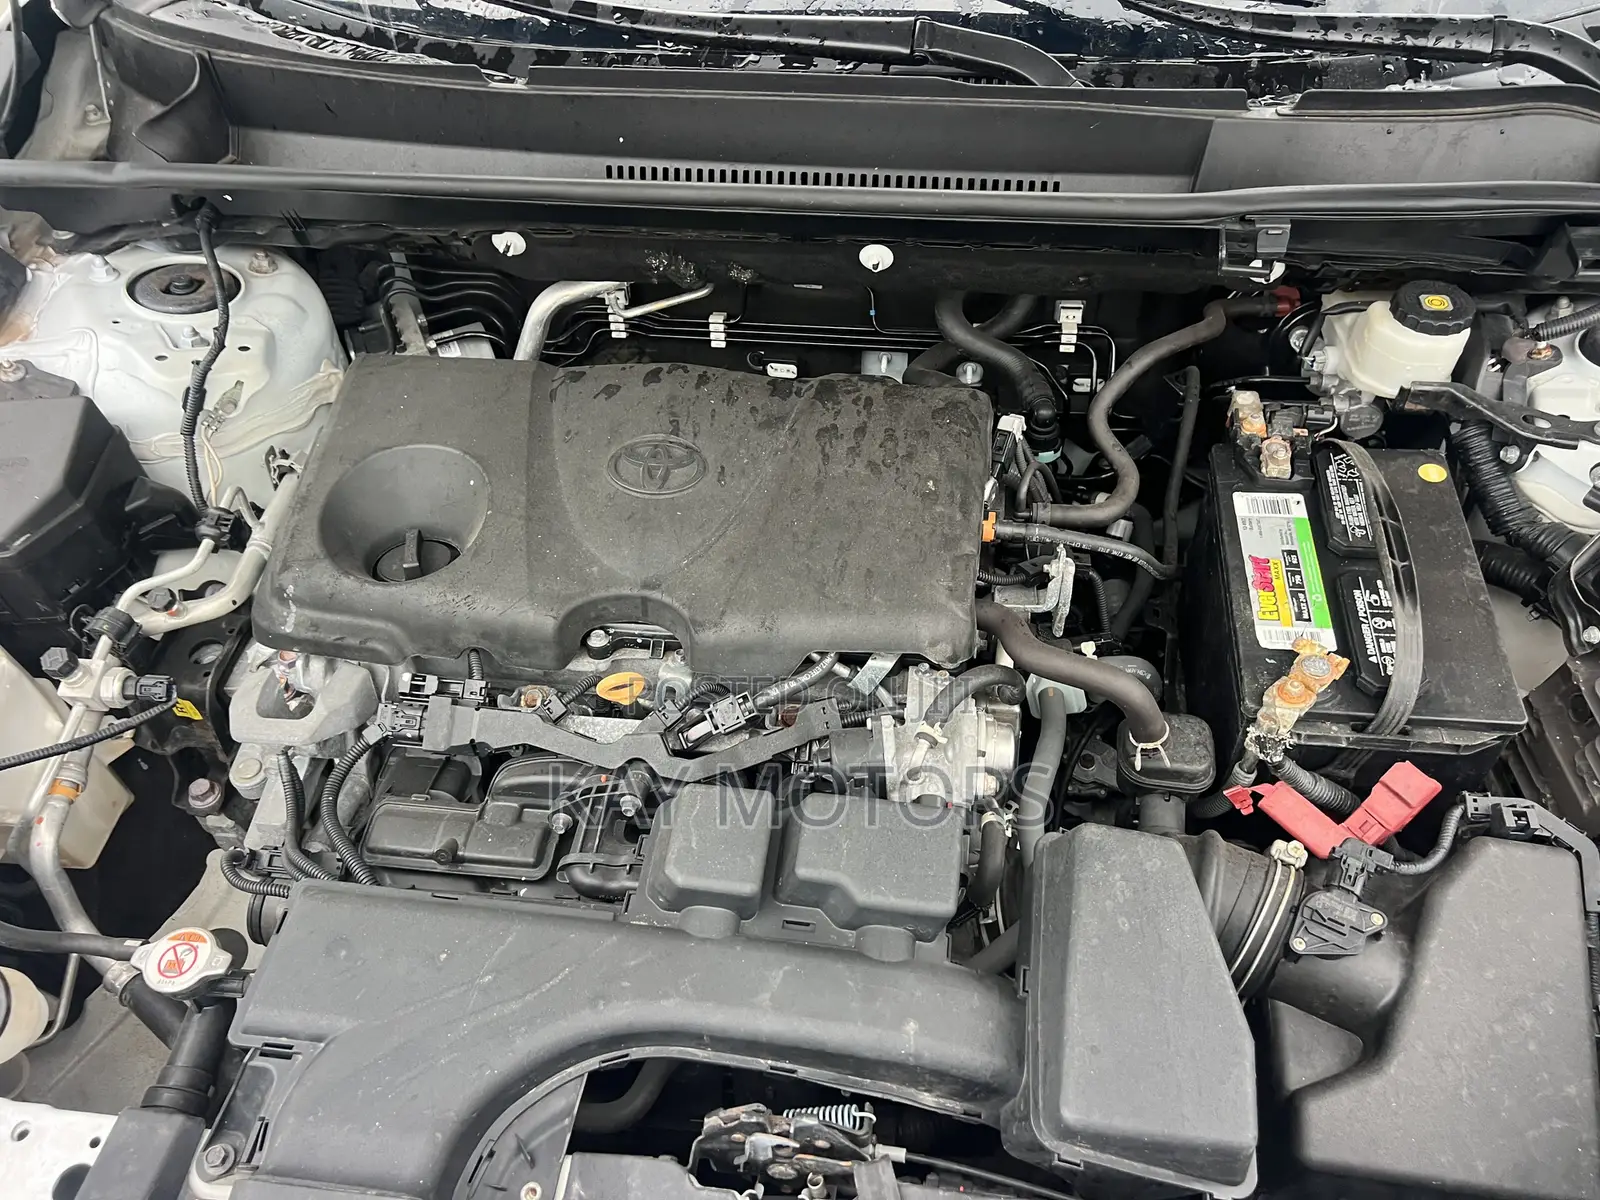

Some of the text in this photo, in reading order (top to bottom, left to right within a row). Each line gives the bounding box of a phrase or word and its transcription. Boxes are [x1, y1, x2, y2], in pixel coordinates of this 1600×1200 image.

[1272, 561, 1281, 580] MAXX
[1248, 554, 1280, 620] EverStart
[1352, 589, 1367, 617] POISON
[1360, 623, 1376, 655] DANGER
